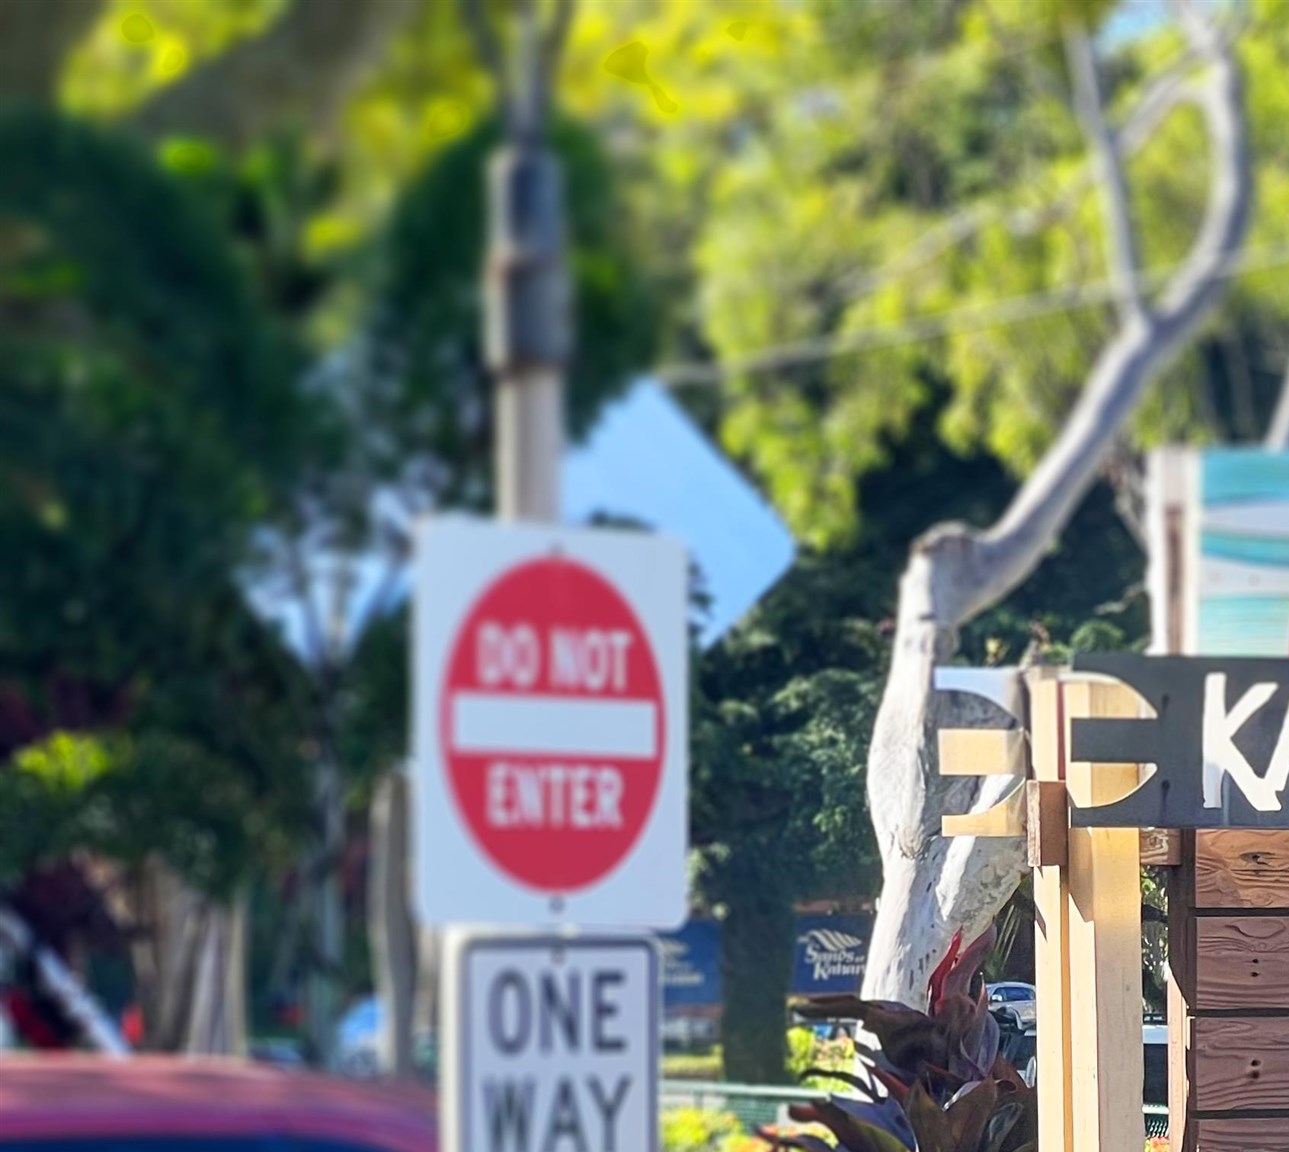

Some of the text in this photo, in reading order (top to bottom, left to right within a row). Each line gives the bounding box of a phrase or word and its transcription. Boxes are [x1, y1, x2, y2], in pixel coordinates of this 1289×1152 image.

[476, 626, 632, 691] DO NOT
[486, 766, 624, 829] ENTER
[488, 968, 628, 1055] ONE
